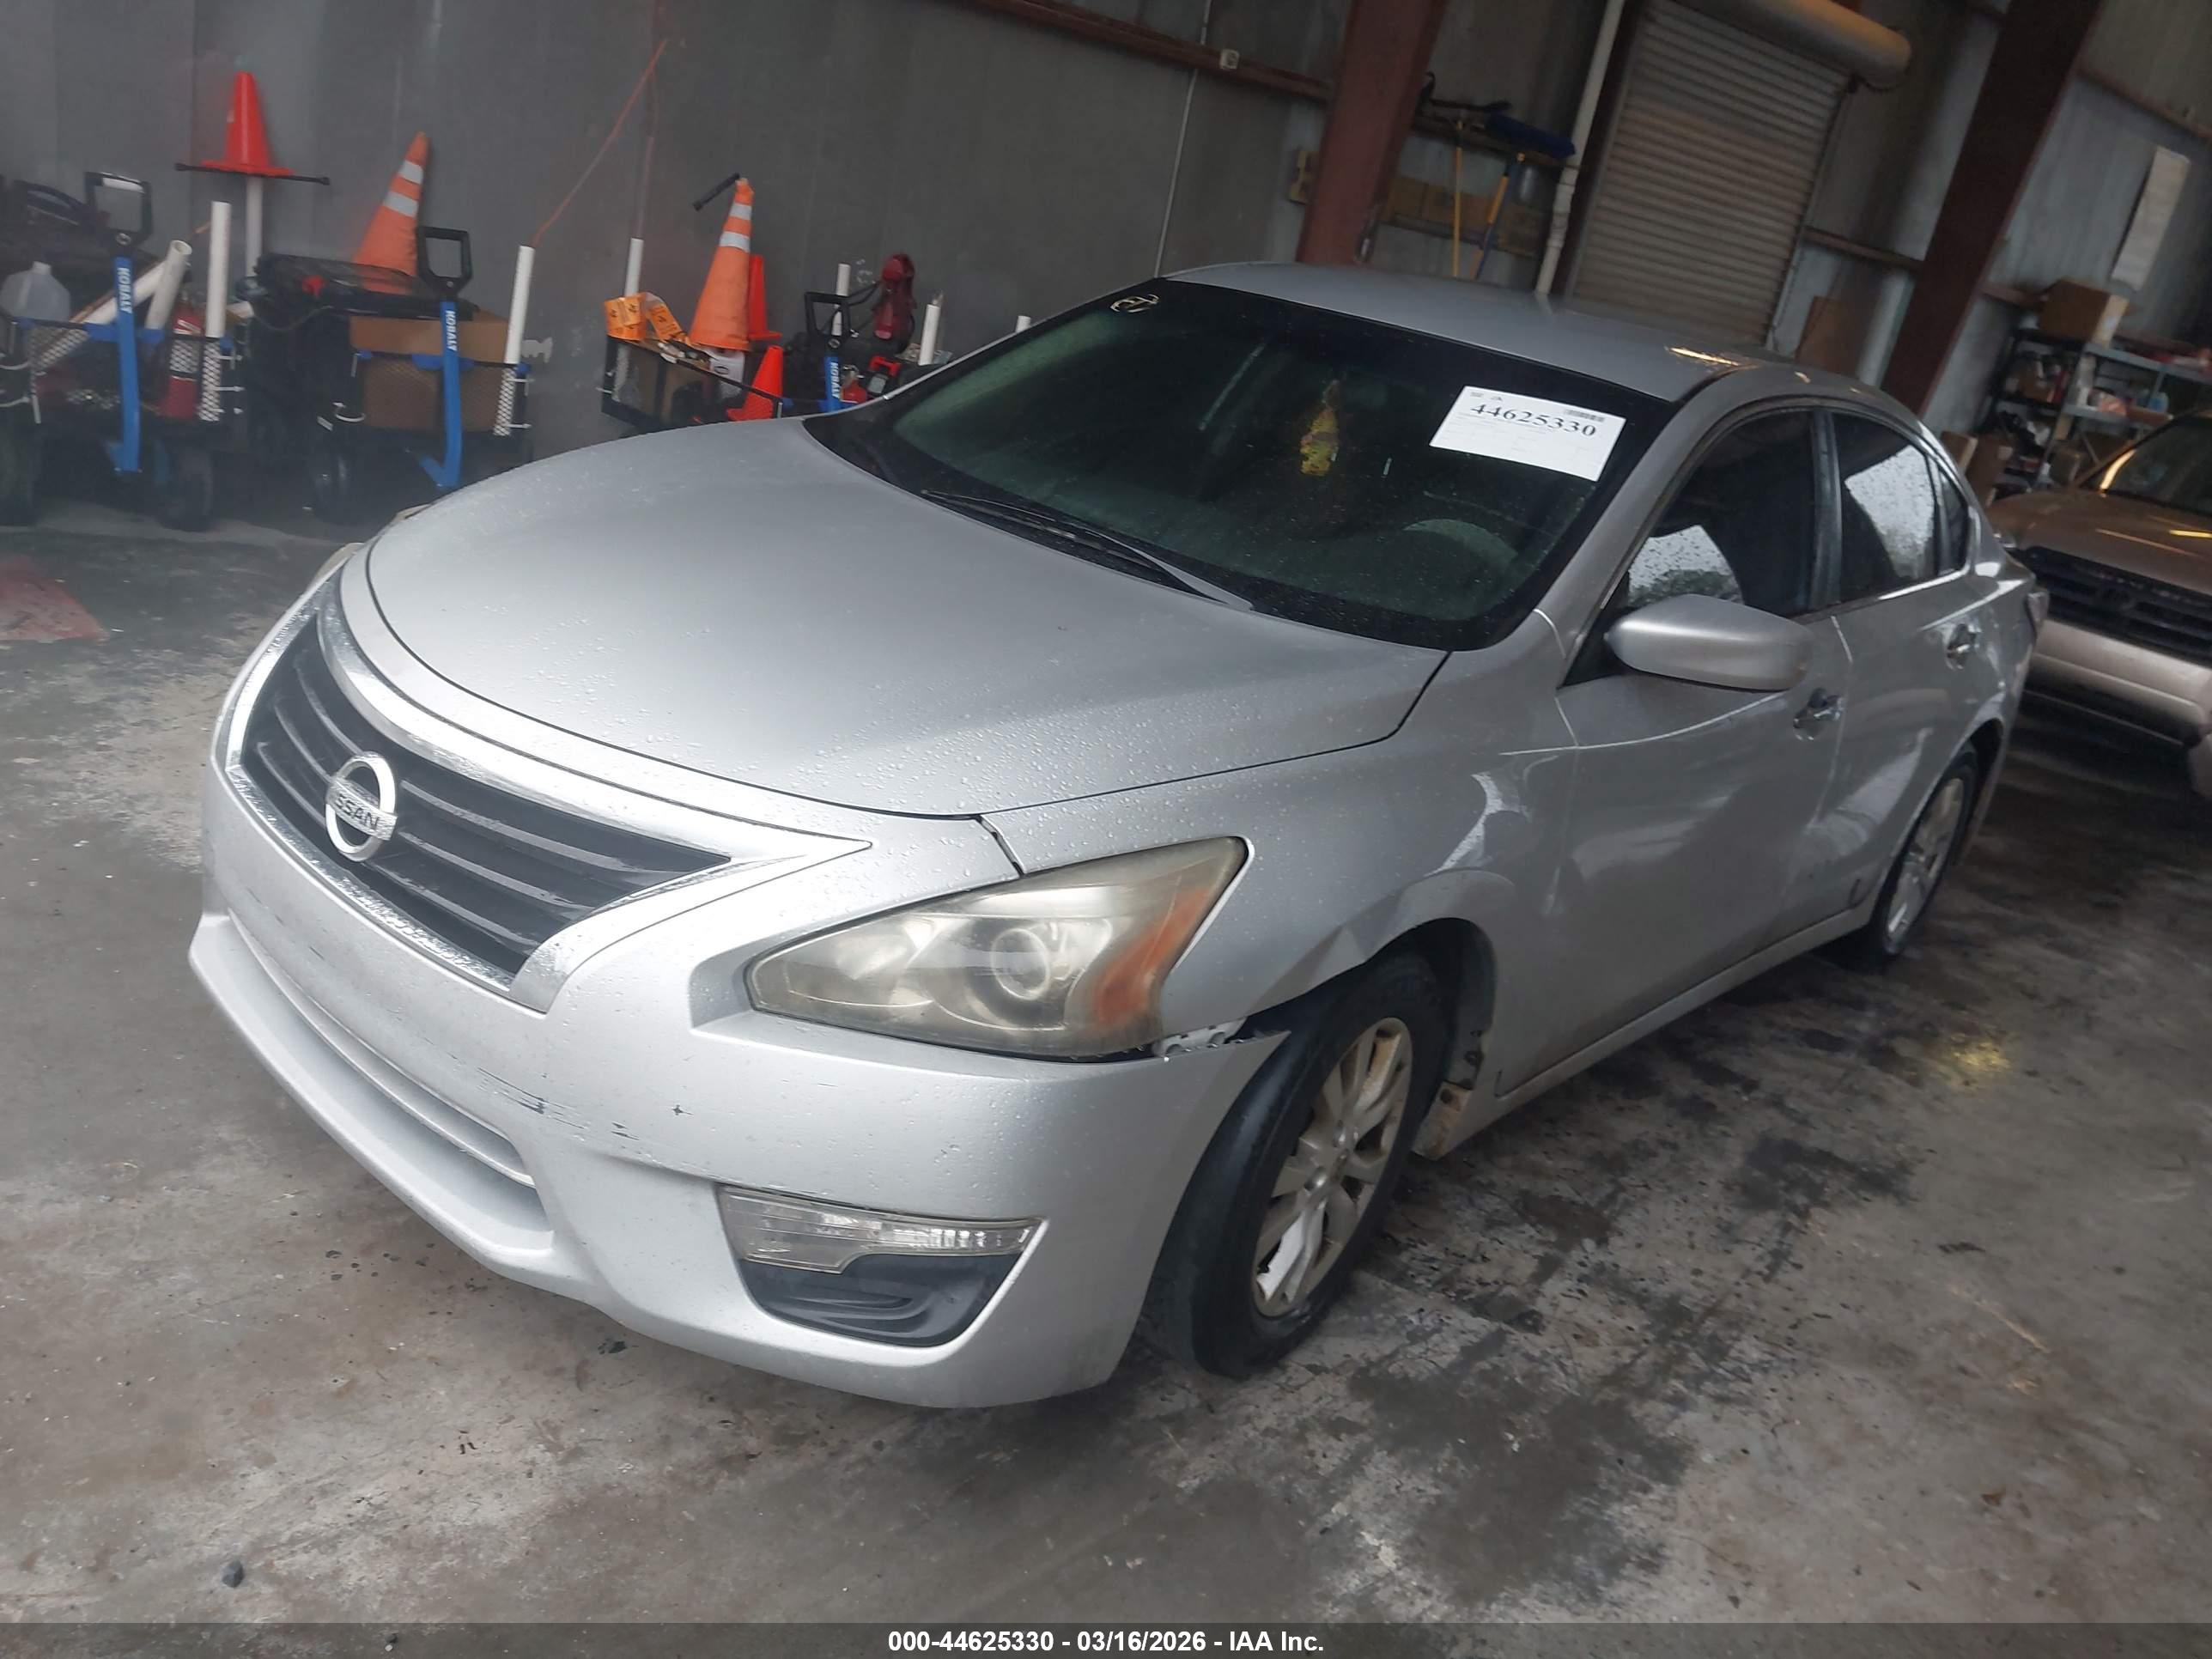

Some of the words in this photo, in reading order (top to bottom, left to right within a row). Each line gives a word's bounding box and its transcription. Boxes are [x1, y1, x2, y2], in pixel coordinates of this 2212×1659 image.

[117, 267, 132, 314] KOBALT
[445, 310, 457, 351] KOBALT
[830, 362, 840, 399] KOBALT
[1469, 403, 1597, 437] 44625330
[331, 792, 380, 830] SSAN
